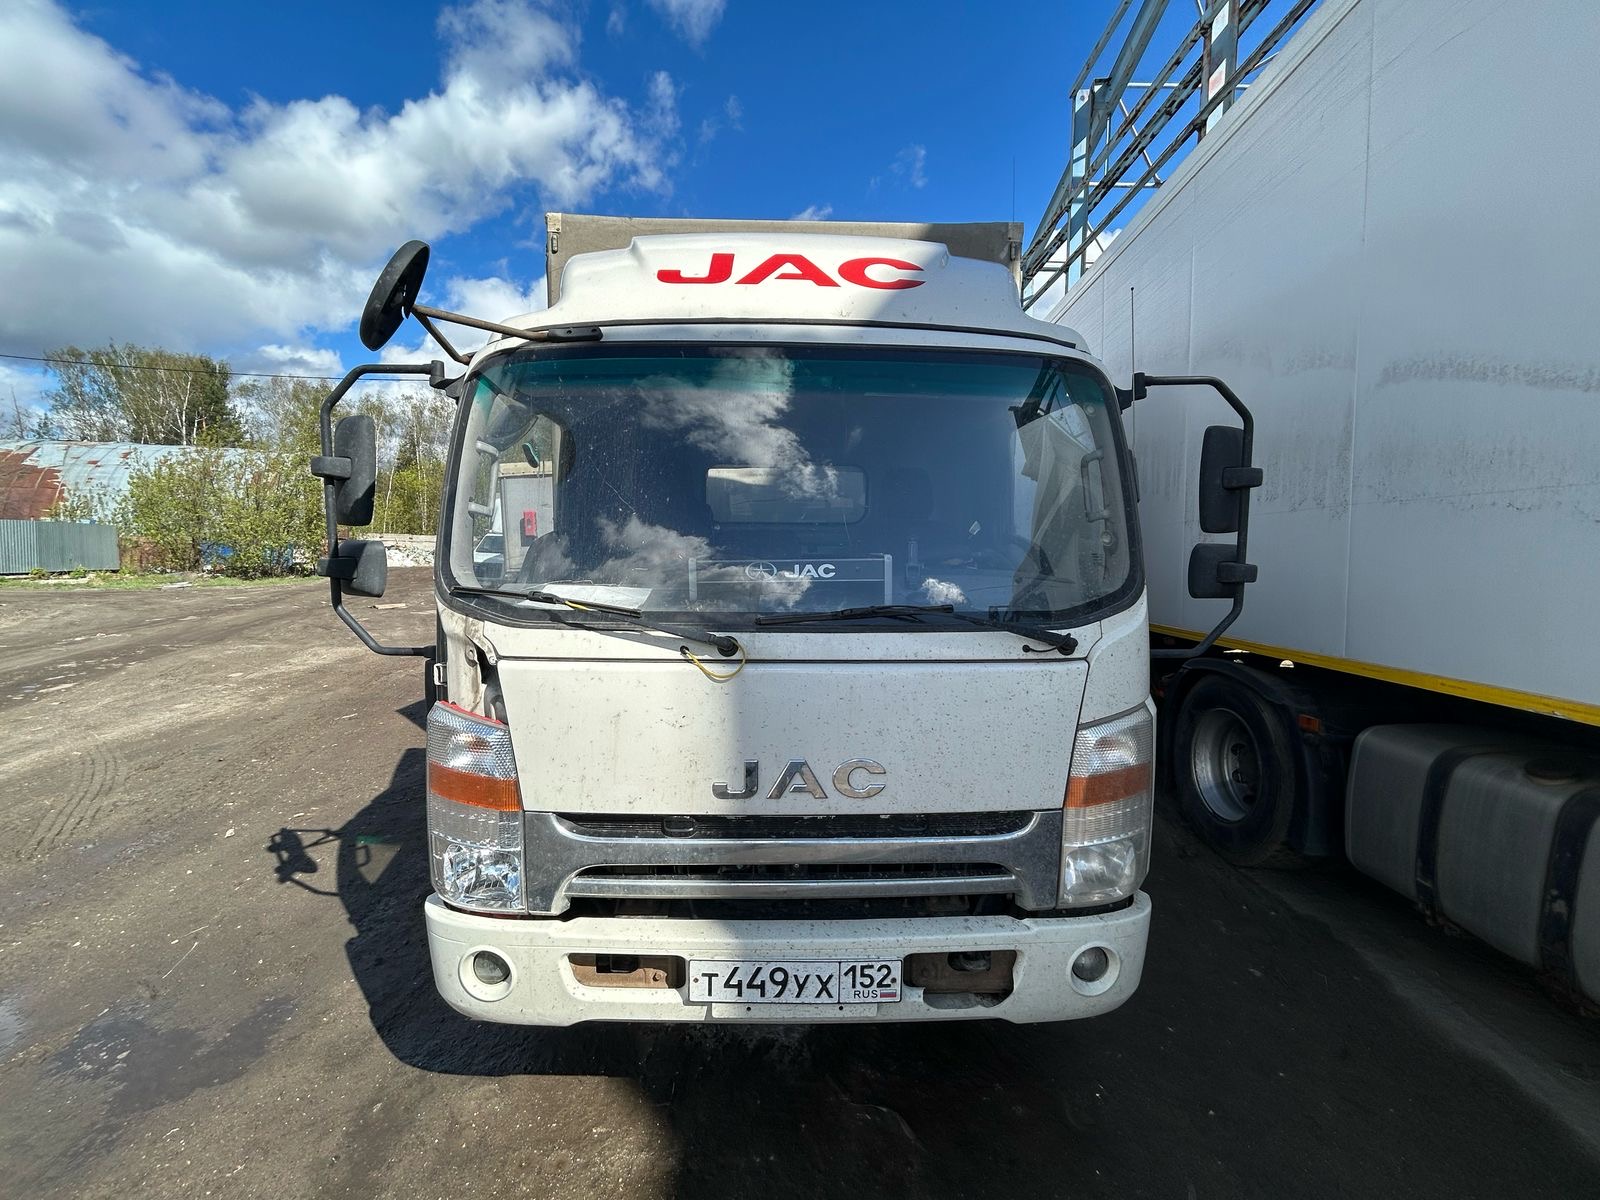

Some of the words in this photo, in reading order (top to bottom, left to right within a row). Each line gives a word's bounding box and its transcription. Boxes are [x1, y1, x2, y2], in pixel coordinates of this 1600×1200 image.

[656, 253, 926, 290] JAC
[784, 563, 836, 578] JAC
[711, 758, 886, 800] JAC
[843, 964, 892, 989] 152
[853, 989, 878, 999] RUS
